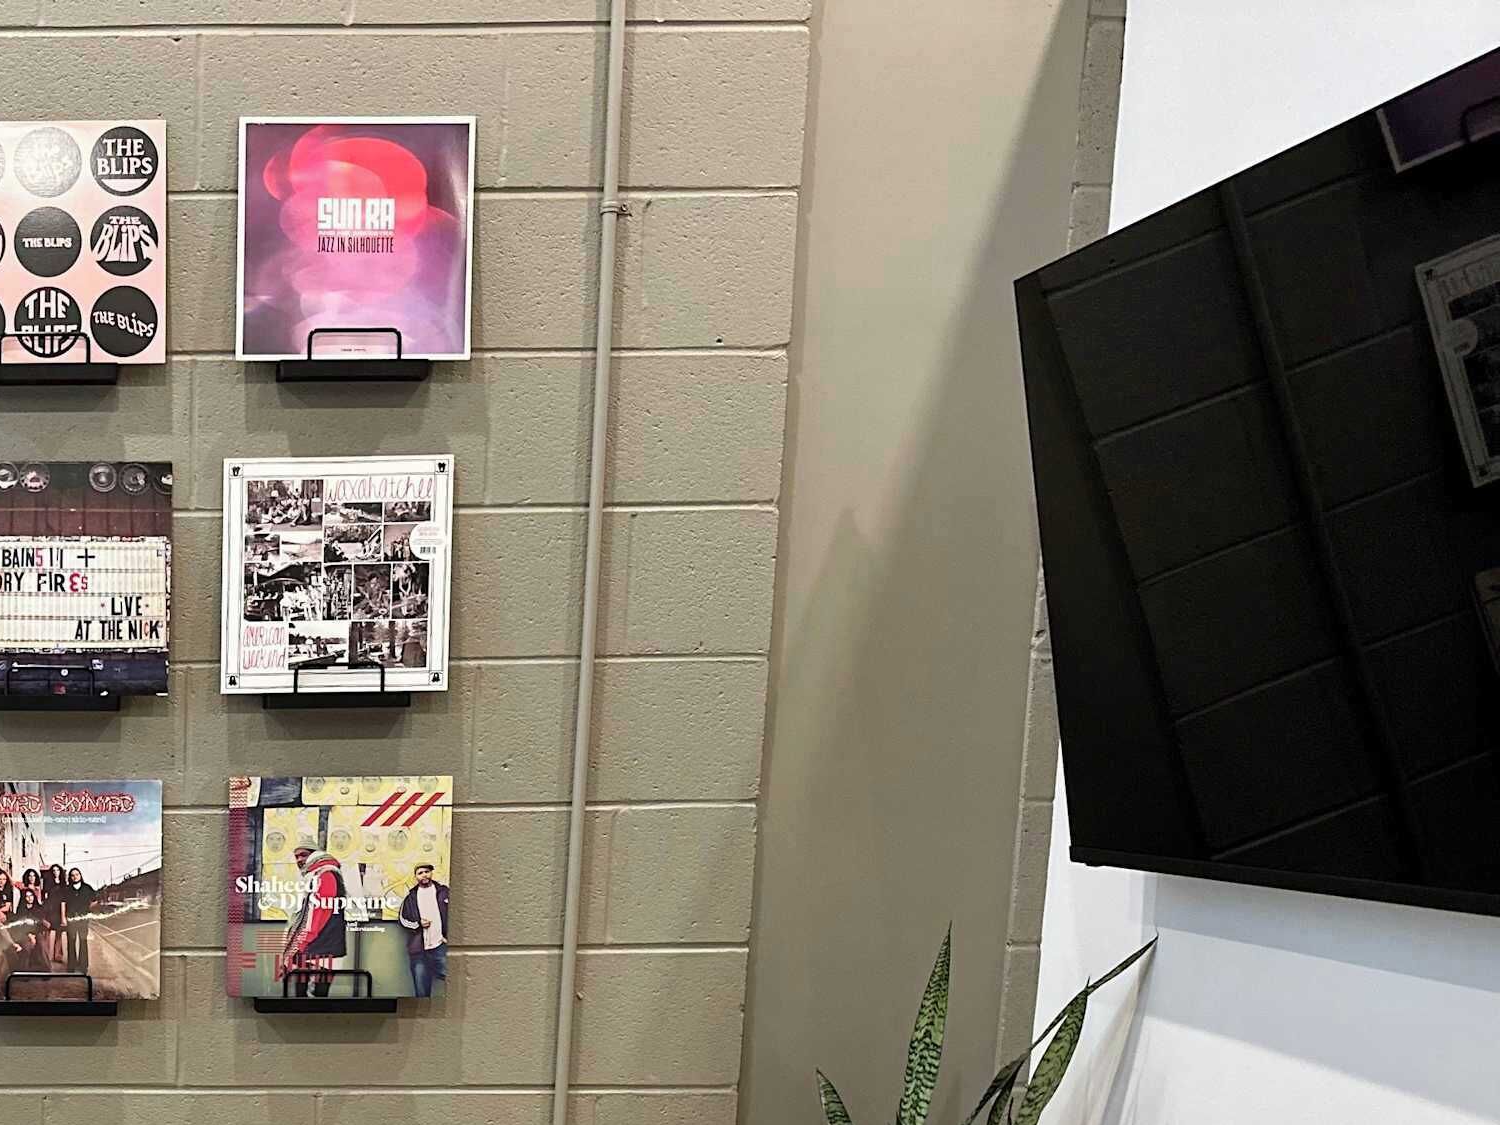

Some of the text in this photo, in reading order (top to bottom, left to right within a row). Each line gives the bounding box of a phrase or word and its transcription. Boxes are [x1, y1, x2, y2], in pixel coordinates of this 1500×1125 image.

[102, 138, 145, 157] THE
[96, 157, 153, 176] BLIPS
[108, 215, 142, 225] THE
[317, 197, 396, 230] SUN RA
[22, 237, 43, 248] THE
[317, 236, 394, 253] JAZZ IN SILHOUETTE
[24, 289, 71, 319] THE
[92, 311, 116, 326] THE
[2, 548, 43, 568] BAINS
[77, 548, 96, 568] +
[36, 572, 89, 592] FIRES
[75, 621, 161, 640] AT THE NICK
[235, 875, 320, 894] Shaheed
[280, 893, 303, 912] DJ
[308, 893, 401, 915] Supreme
